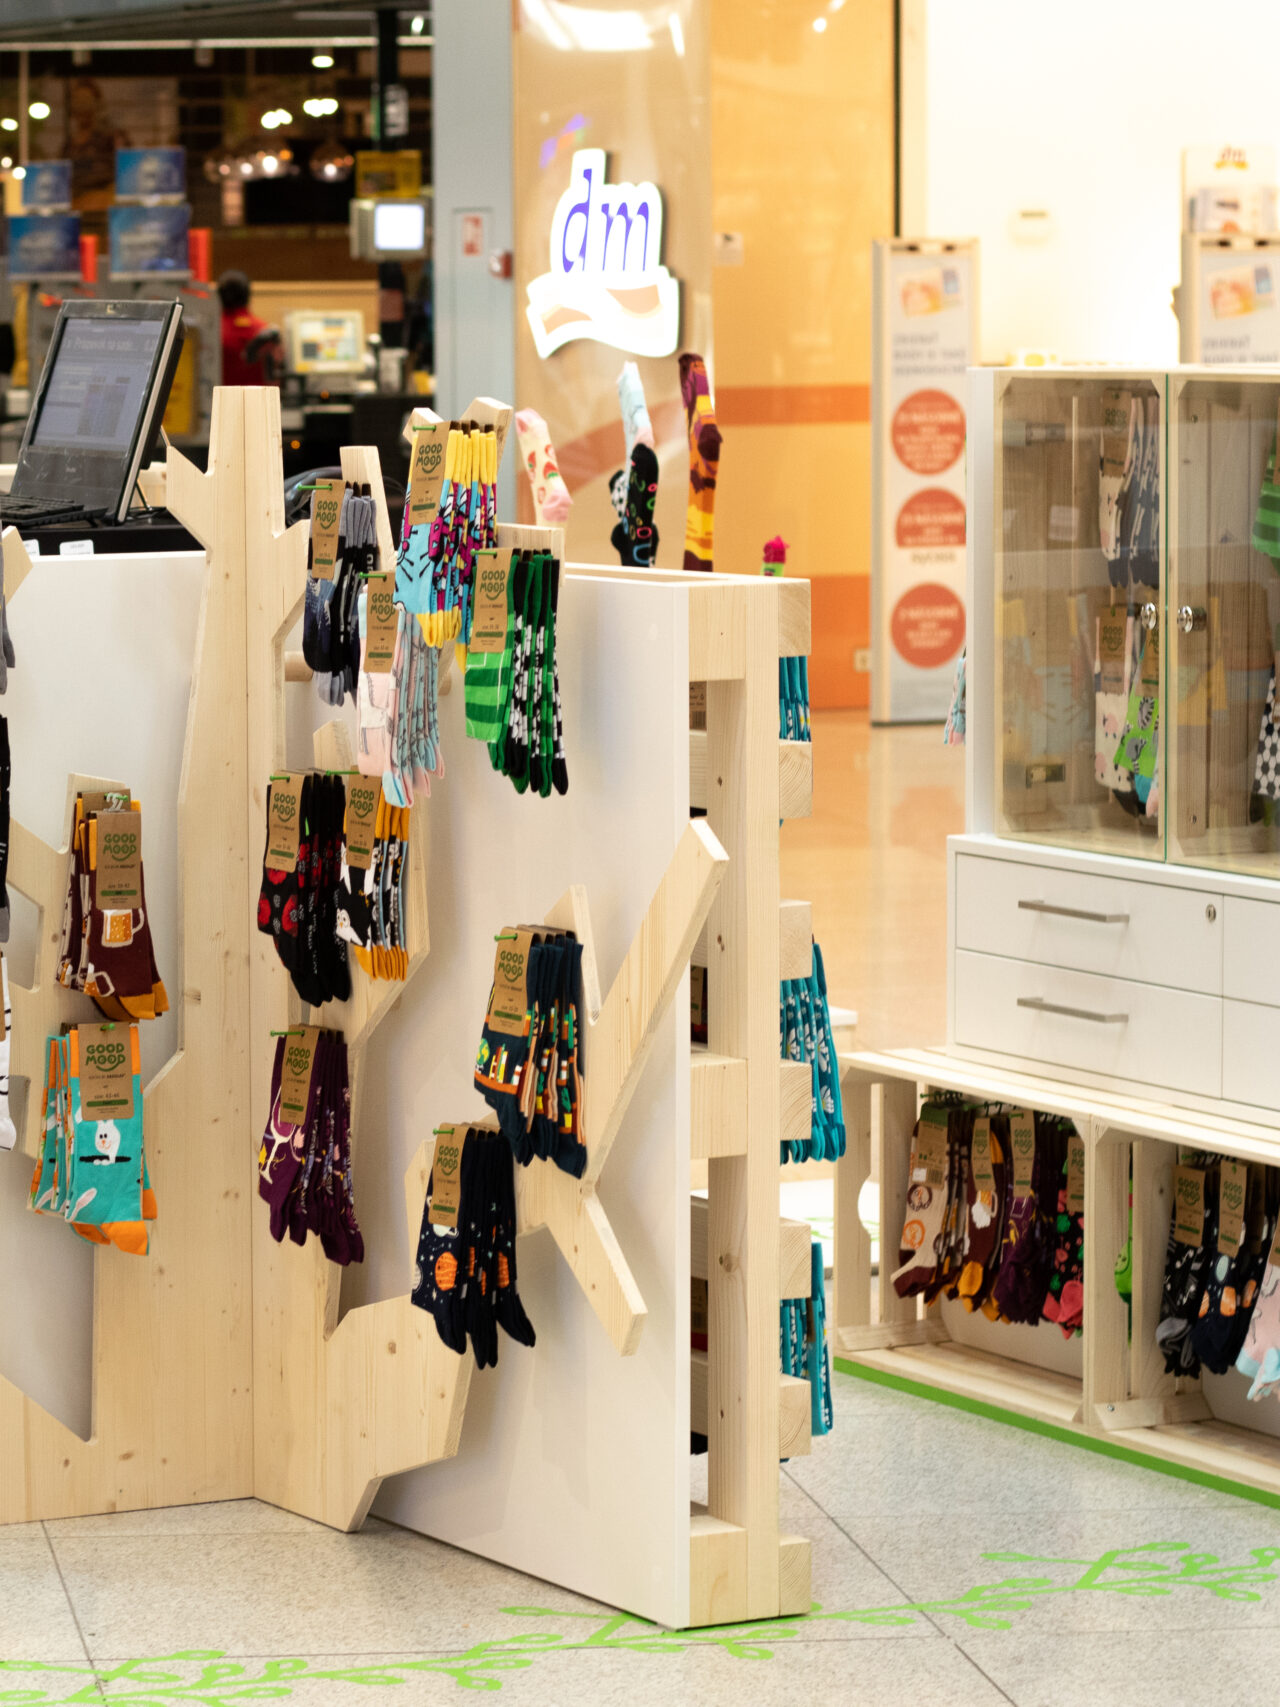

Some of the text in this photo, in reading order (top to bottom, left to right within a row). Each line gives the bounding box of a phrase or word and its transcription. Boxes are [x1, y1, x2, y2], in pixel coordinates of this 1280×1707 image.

[562, 167, 650, 273] dm
[419, 443, 443, 455] GOOD
[416, 455, 442, 468] MOOD
[317, 500, 339, 512] GOOD
[316, 511, 337, 523] MOOD
[481, 570, 506, 581] GOOD
[480, 582, 505, 593] MOOD
[274, 792, 297, 806] GOOD
[351, 788, 375, 801] GOOD
[272, 803, 296, 817] MOOD
[349, 799, 374, 813] MOOD
[104, 833, 137, 843] GOOD
[103, 844, 137, 855] MOOD
[500, 950, 524, 965] GOOD
[497, 962, 523, 977] MOOD
[86, 1042, 125, 1054] GOOD
[288, 1046, 311, 1059] GOOD
[85, 1054, 126, 1066] MOOD
[286, 1057, 309, 1070] MOOD
[439, 1145, 459, 1158] GOOD
[437, 1156, 458, 1170] MOOD
